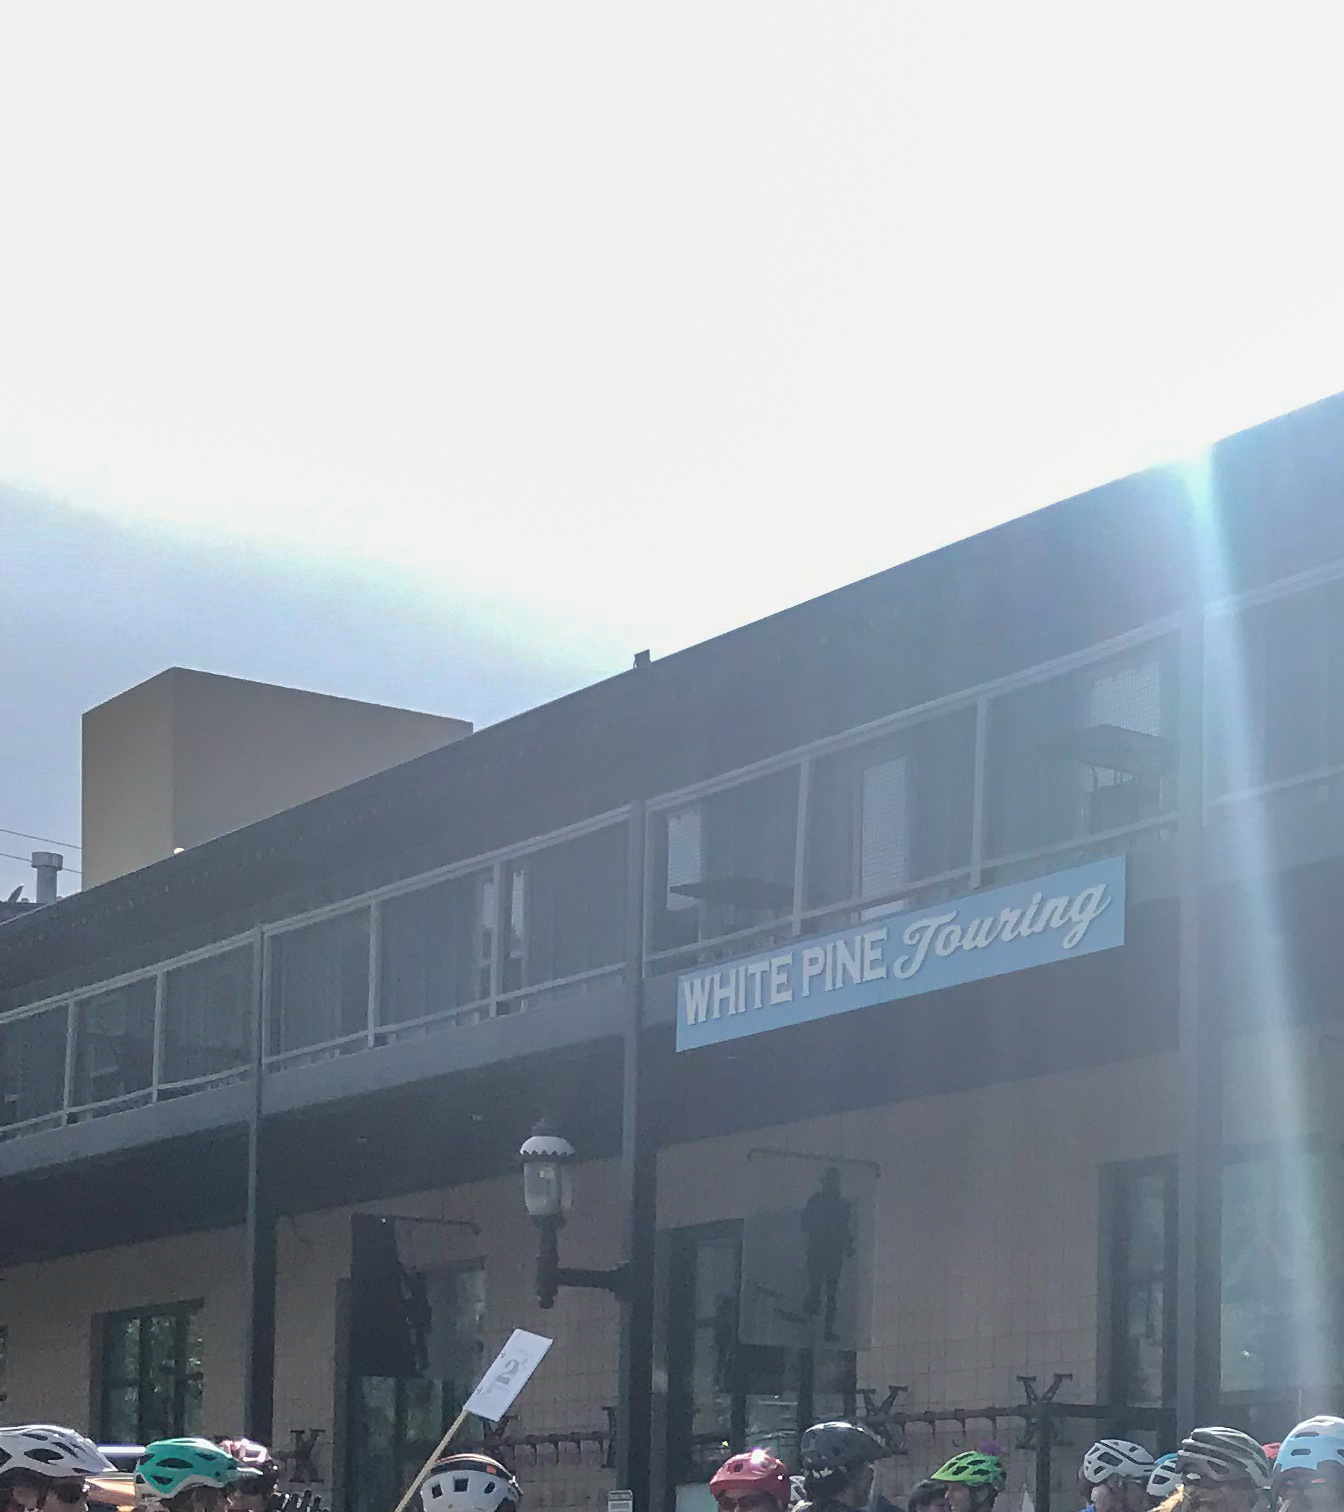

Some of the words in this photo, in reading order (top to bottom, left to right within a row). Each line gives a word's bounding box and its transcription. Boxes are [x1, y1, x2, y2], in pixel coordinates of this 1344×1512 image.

[683, 951, 794, 1025] WHITE
[801, 926, 888, 997] PINE
[893, 882, 1112, 980] Touring
[494, 1358, 521, 1386] 2
